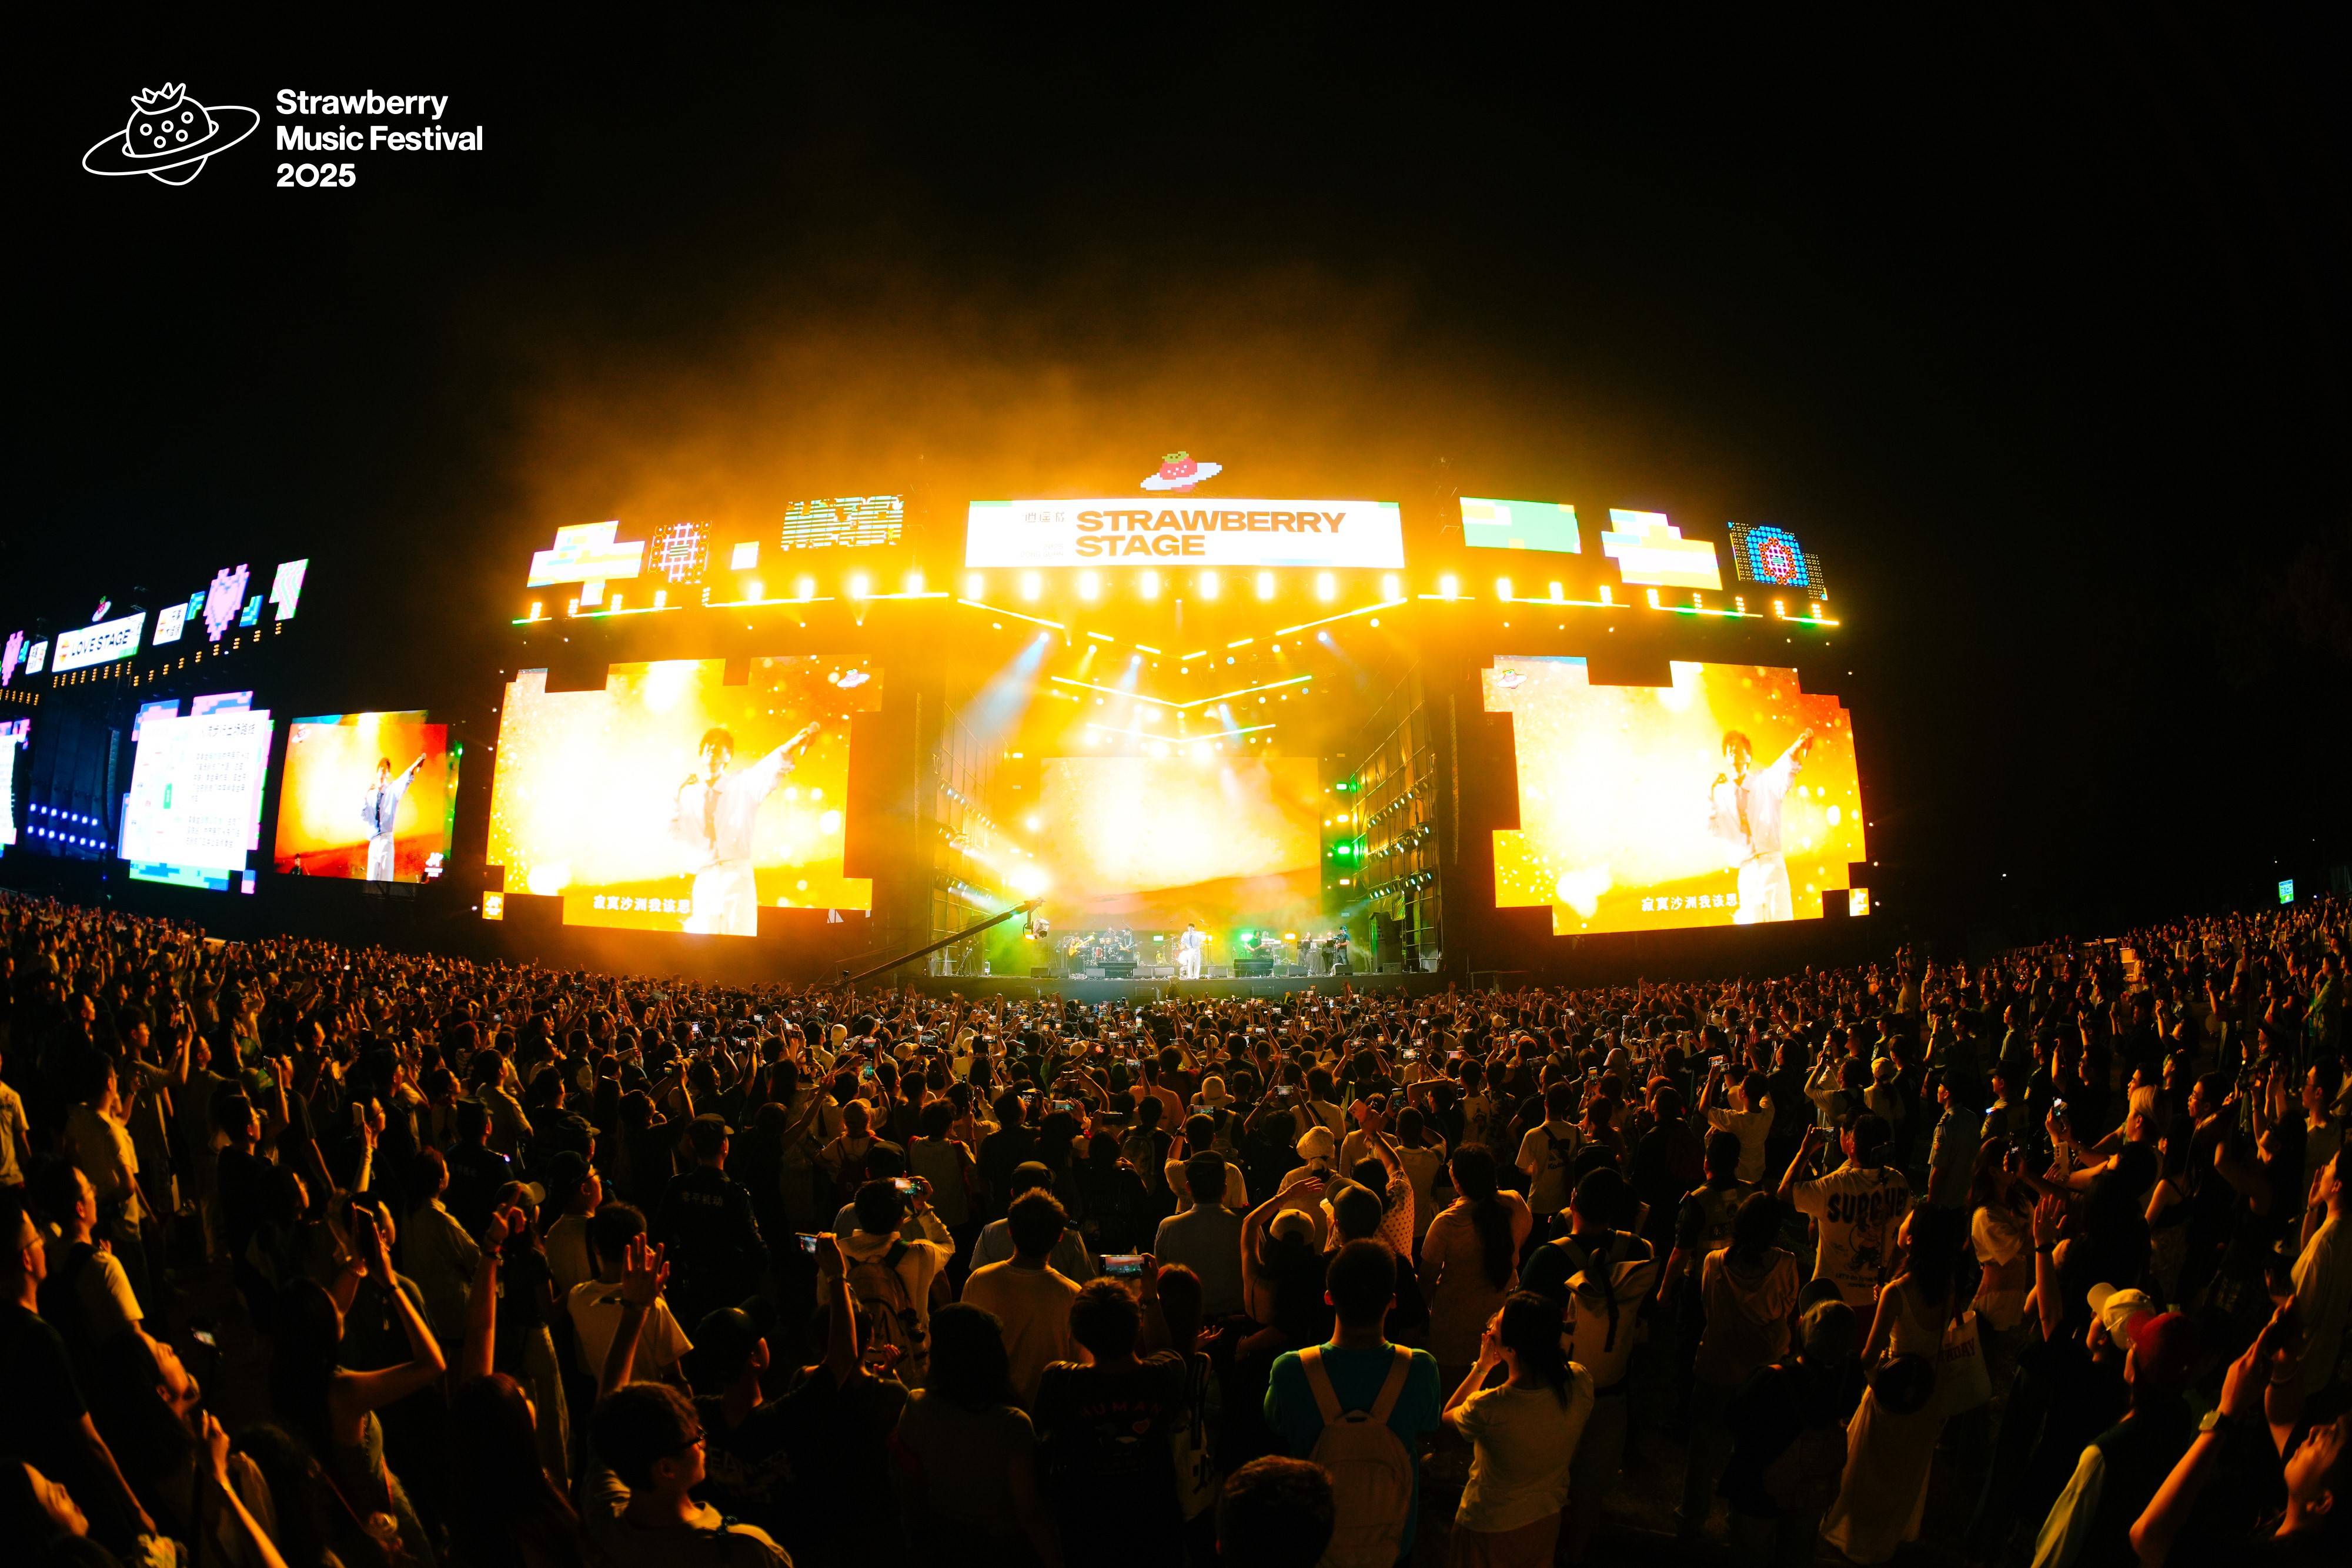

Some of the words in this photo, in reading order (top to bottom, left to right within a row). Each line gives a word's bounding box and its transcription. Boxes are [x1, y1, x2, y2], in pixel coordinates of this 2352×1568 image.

[1076, 510, 1346, 533] STRAWBERRY
[1075, 534, 1205, 557] STAGE
[71, 637, 96, 656] LOVE
[97, 629, 131, 650] STAGE
